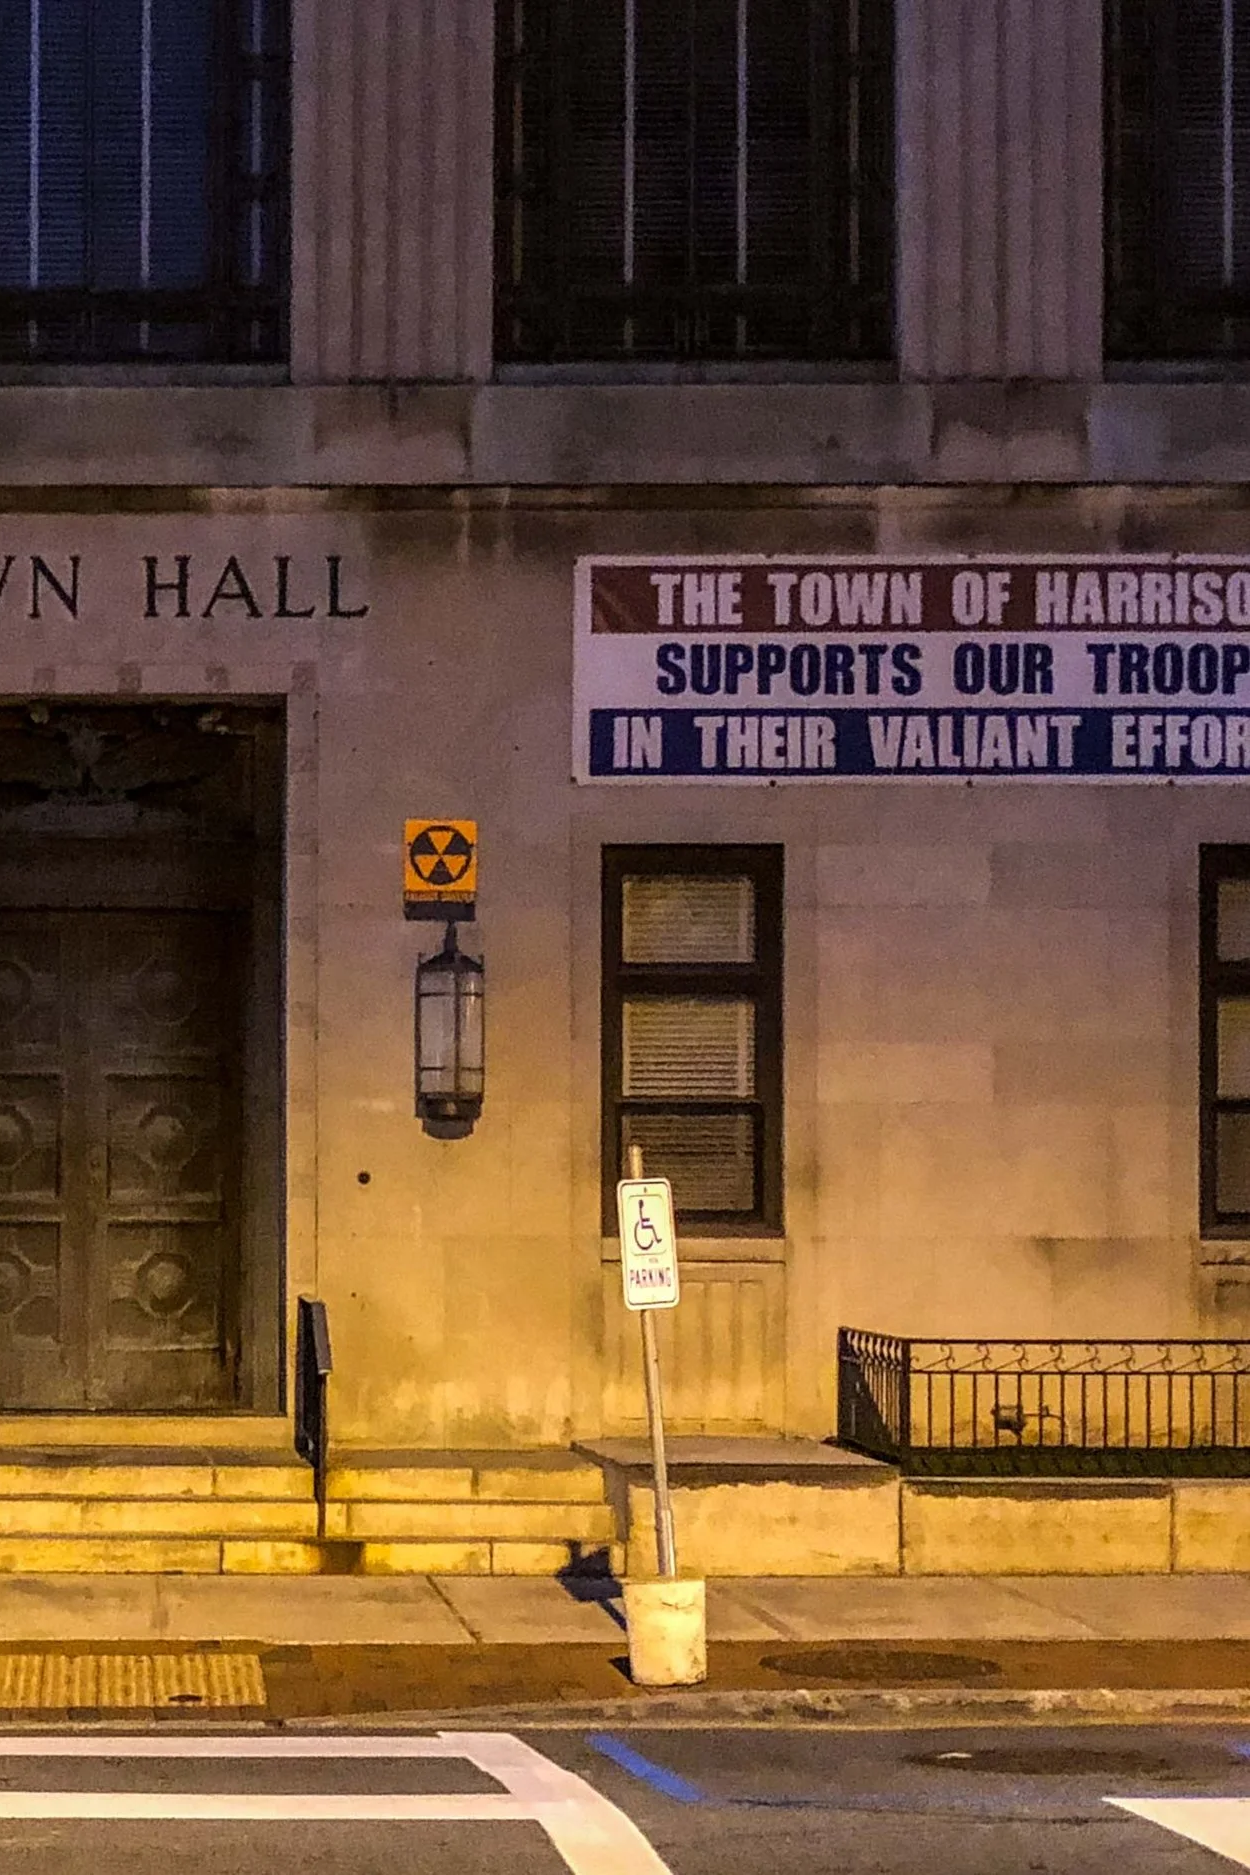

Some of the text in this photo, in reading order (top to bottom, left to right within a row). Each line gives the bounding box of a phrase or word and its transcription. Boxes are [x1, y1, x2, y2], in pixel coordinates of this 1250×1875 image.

[142, 554, 370, 619] HALL
[650, 570, 1250, 626] THE TOWN OF HARRISO
[656, 642, 1250, 696] SUPPORTS OUR TROOP
[612, 714, 1250, 769] IN THEIR VALIANT EFFOR
[629, 1267, 672, 1289] PARKING
